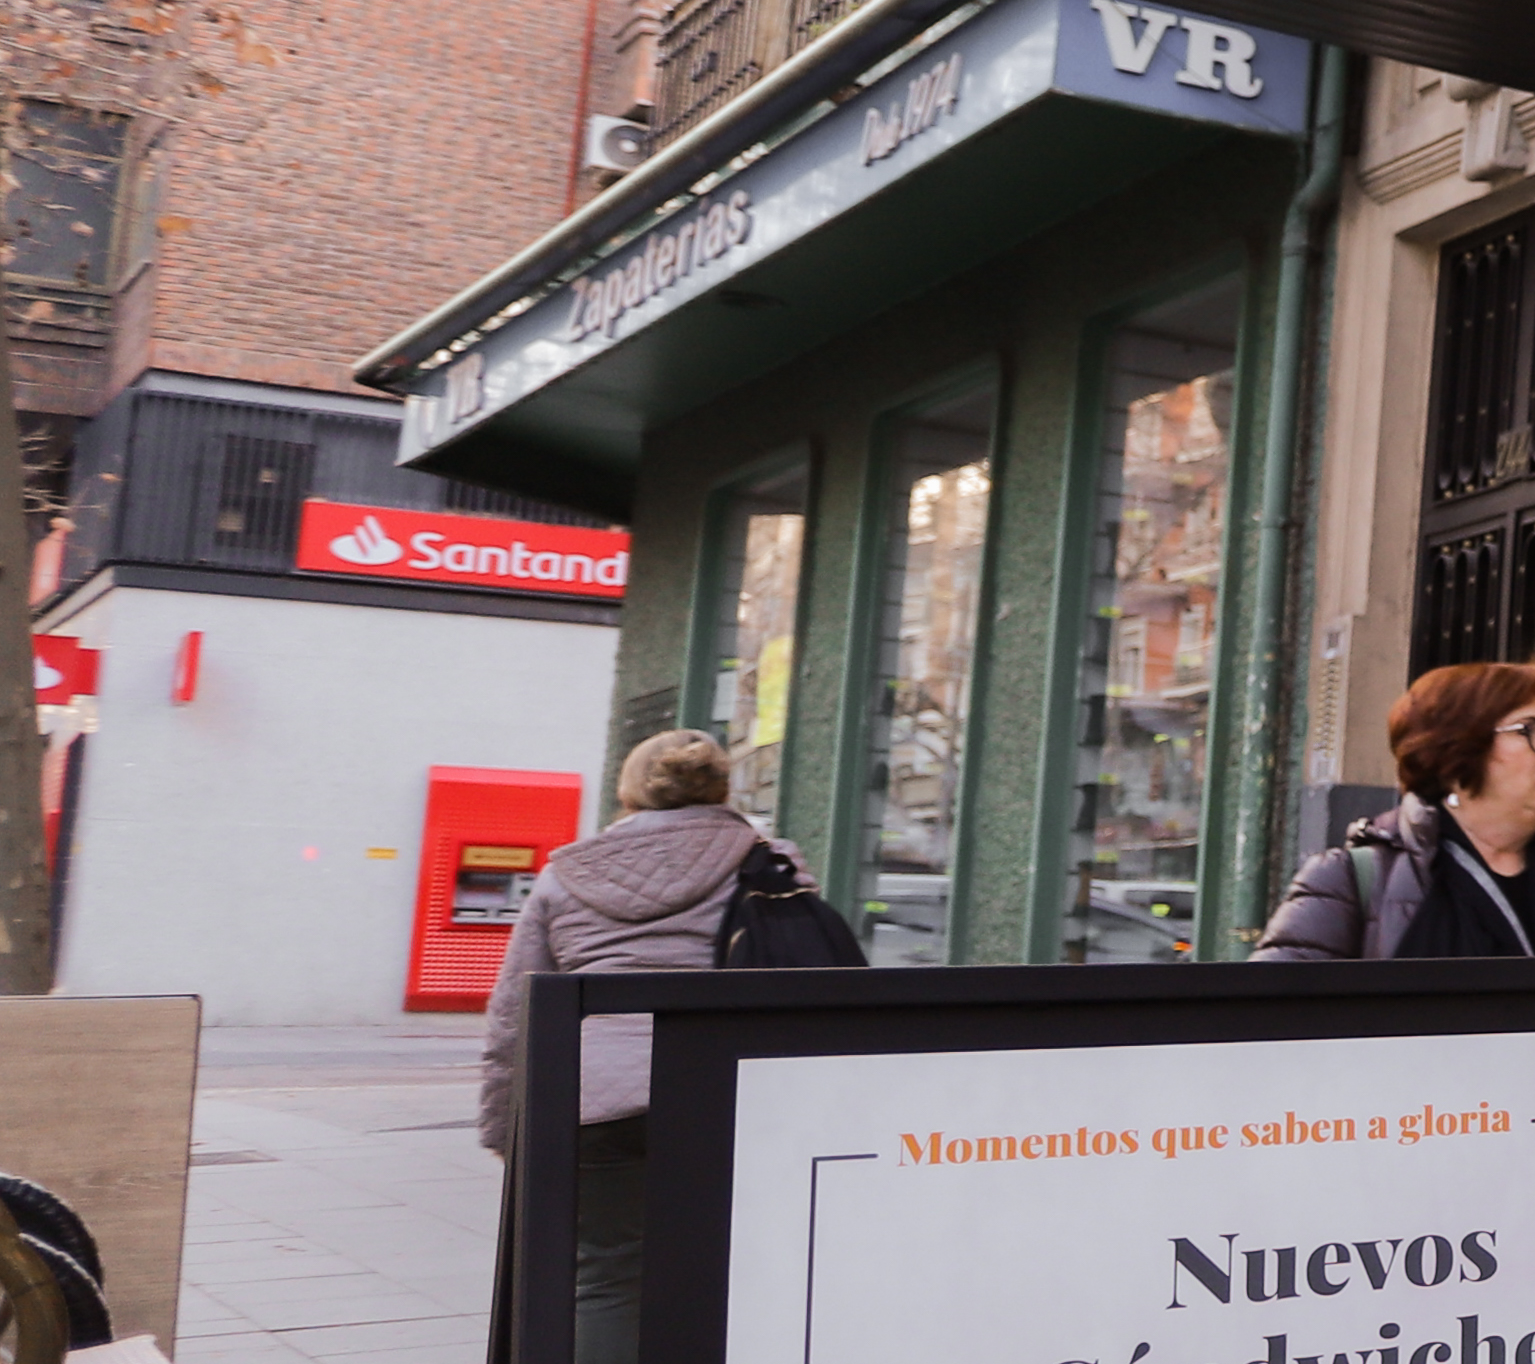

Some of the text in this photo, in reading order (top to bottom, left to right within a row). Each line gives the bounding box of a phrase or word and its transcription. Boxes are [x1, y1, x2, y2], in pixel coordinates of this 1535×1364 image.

[567, 189, 752, 342] Zapaterías
[407, 531, 629, 586] Santand
[899, 1102, 1510, 1166] Momentos que saben a gloria
[1167, 1231, 1497, 1309] Nuevos
